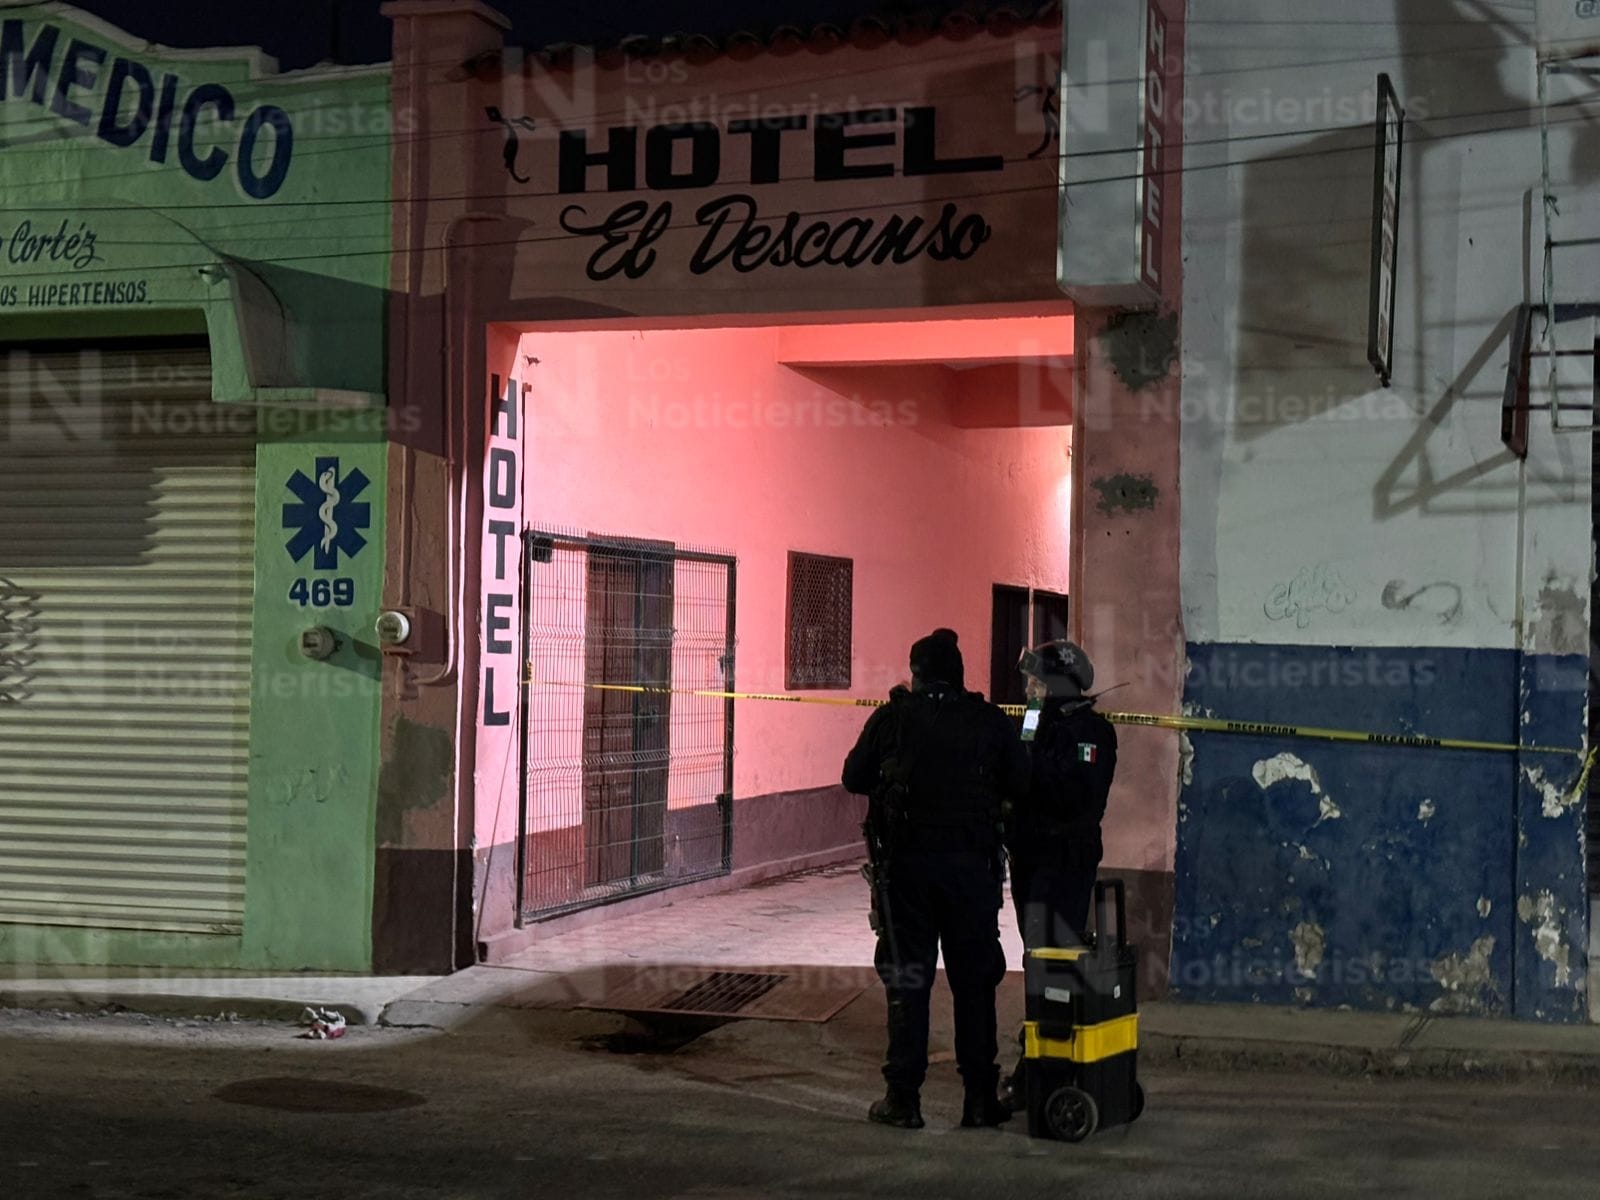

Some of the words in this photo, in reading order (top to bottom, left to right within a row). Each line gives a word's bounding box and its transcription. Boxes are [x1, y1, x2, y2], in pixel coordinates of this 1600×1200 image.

[0, 19, 294, 199] MEDICO
[558, 107, 1004, 193] HOTEL
[1147, 8, 1164, 284] HOTEL
[8, 219, 106, 269] Cortéz
[559, 200, 671, 281] El
[689, 194, 992, 275] Descanso
[289, 577, 354, 607] 469
[484, 373, 517, 726] HOTEL
